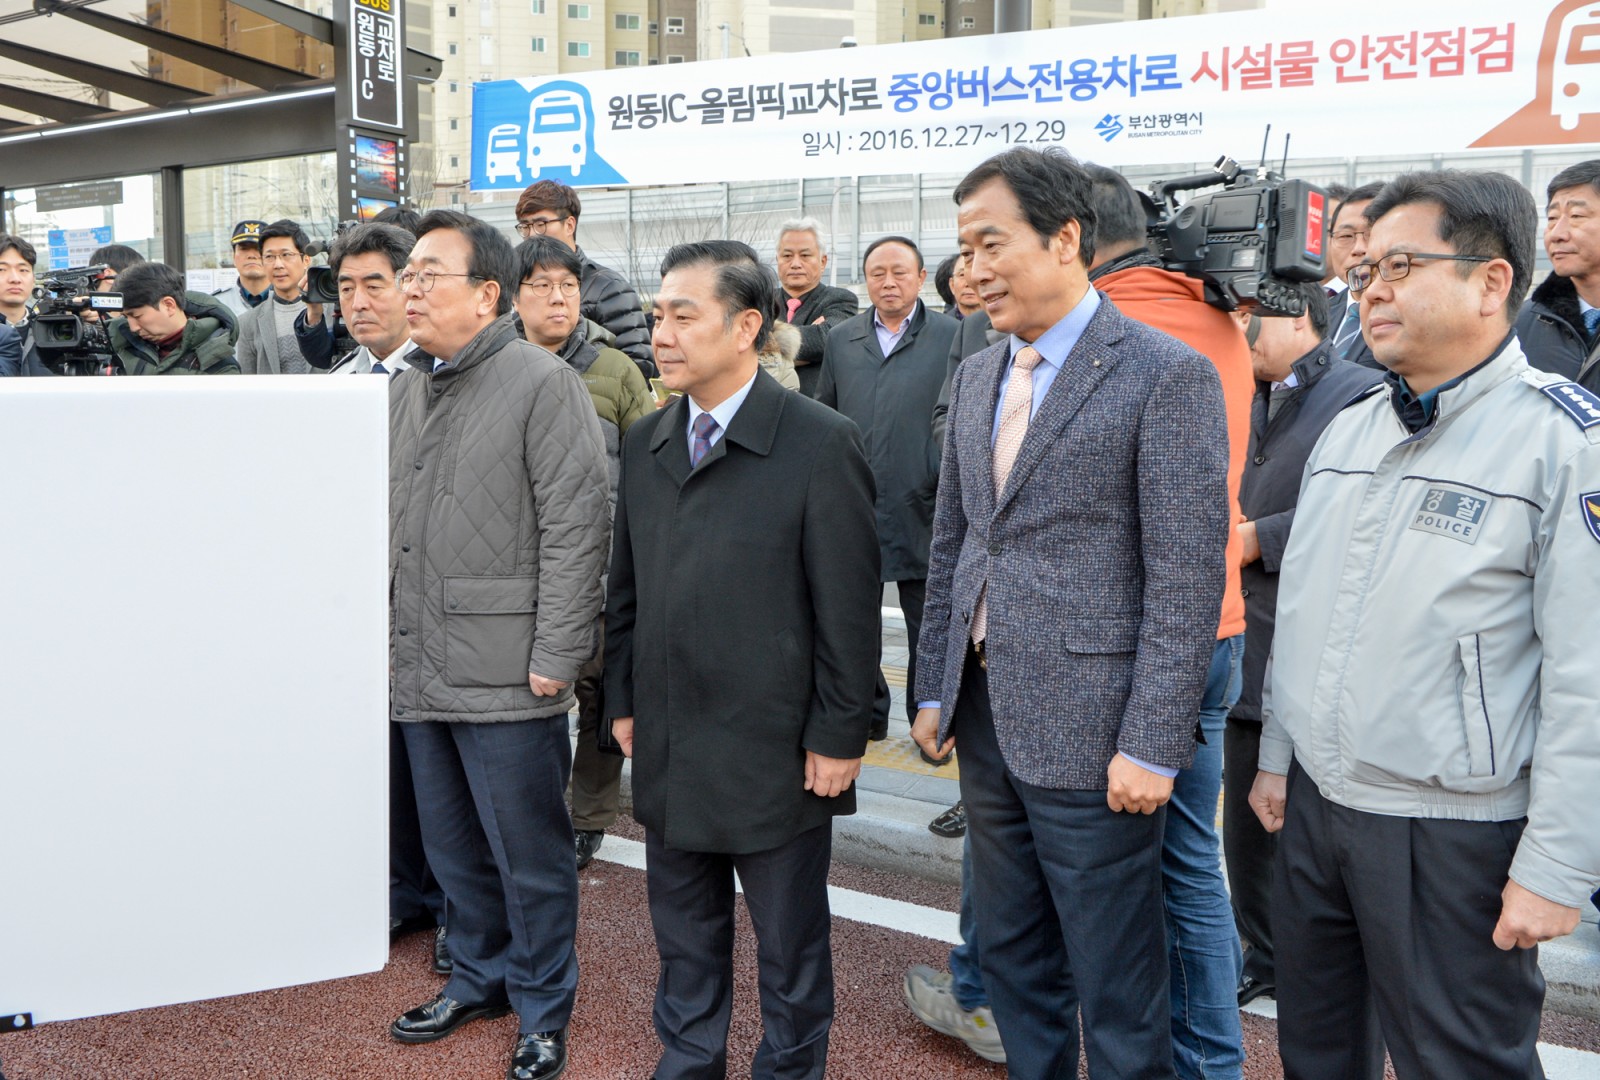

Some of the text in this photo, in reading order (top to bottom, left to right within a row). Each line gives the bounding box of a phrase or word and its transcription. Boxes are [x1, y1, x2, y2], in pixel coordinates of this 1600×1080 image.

[377, 18, 395, 82] 교차로
[887, 54, 1183, 113] 중앙버스전용차로
[1190, 40, 1319, 91] 시설물
[1329, 22, 1516, 84] 안전점검
[858, 120, 1066, 151] 2016.12.27~12.29
[1129, 112, 1203, 129] 부산광역시
[1415, 515, 1472, 537] POLICE
